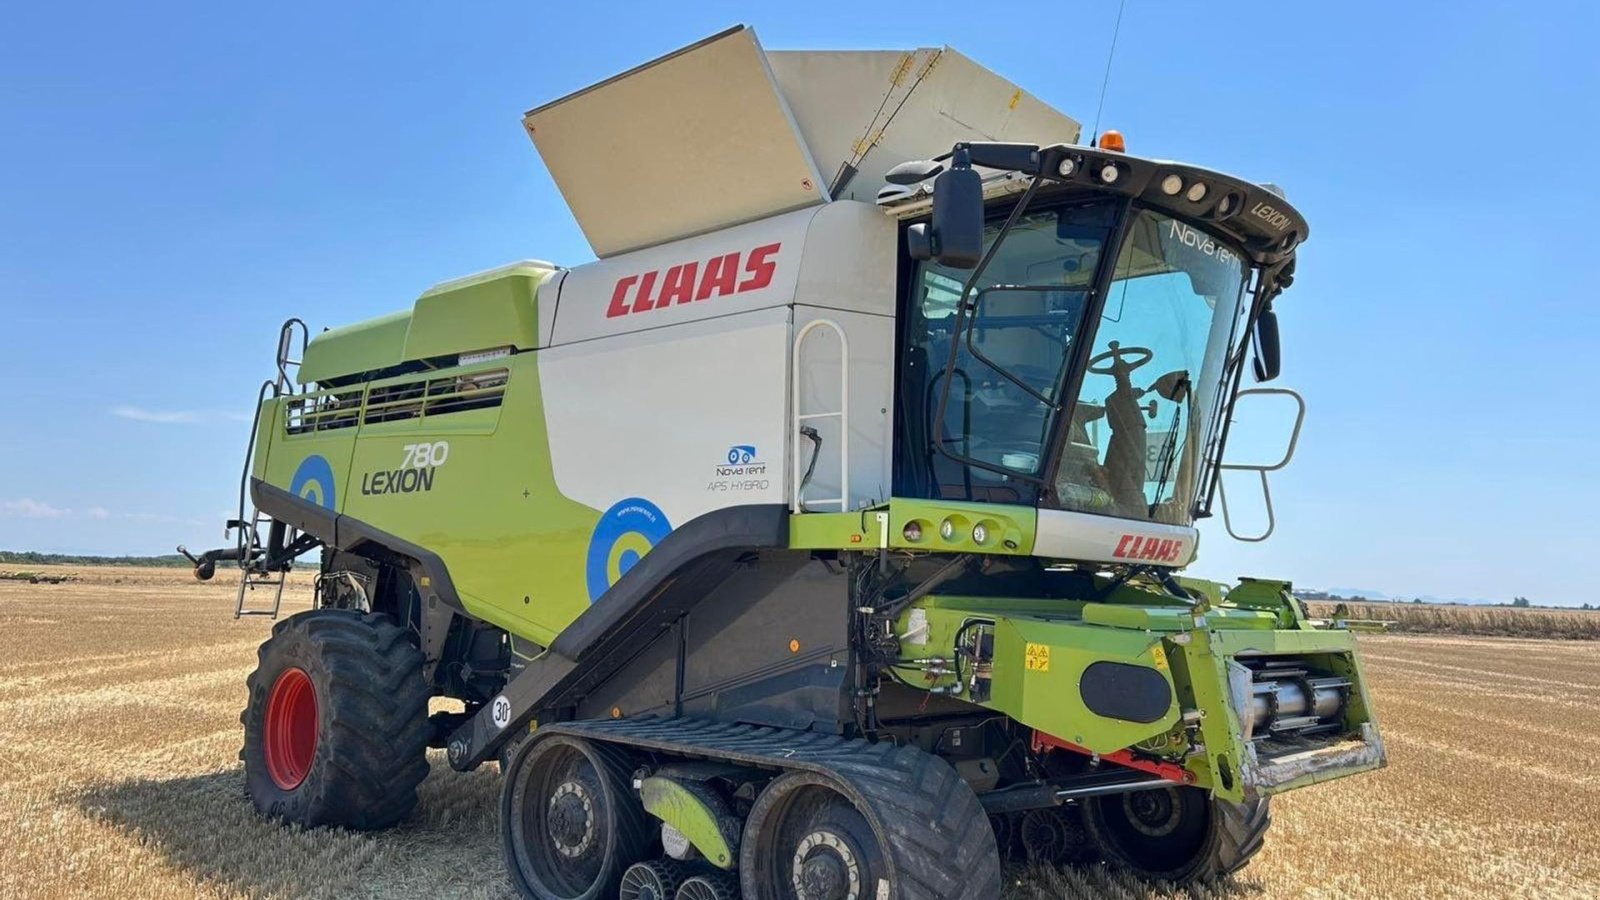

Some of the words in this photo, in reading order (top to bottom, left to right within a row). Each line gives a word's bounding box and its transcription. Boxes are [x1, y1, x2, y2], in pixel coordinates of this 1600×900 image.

[1251, 202, 1292, 231] LEXION
[1169, 220, 1215, 255] Nova
[606, 242, 782, 319] CLAAS
[400, 441, 449, 469] 780
[361, 467, 436, 496] LEXION
[716, 467, 744, 476] Nova
[745, 465, 766, 475] rent
[707, 481, 728, 491] APS
[1112, 534, 1183, 562] CLAAS
[495, 701, 508, 722] 30
